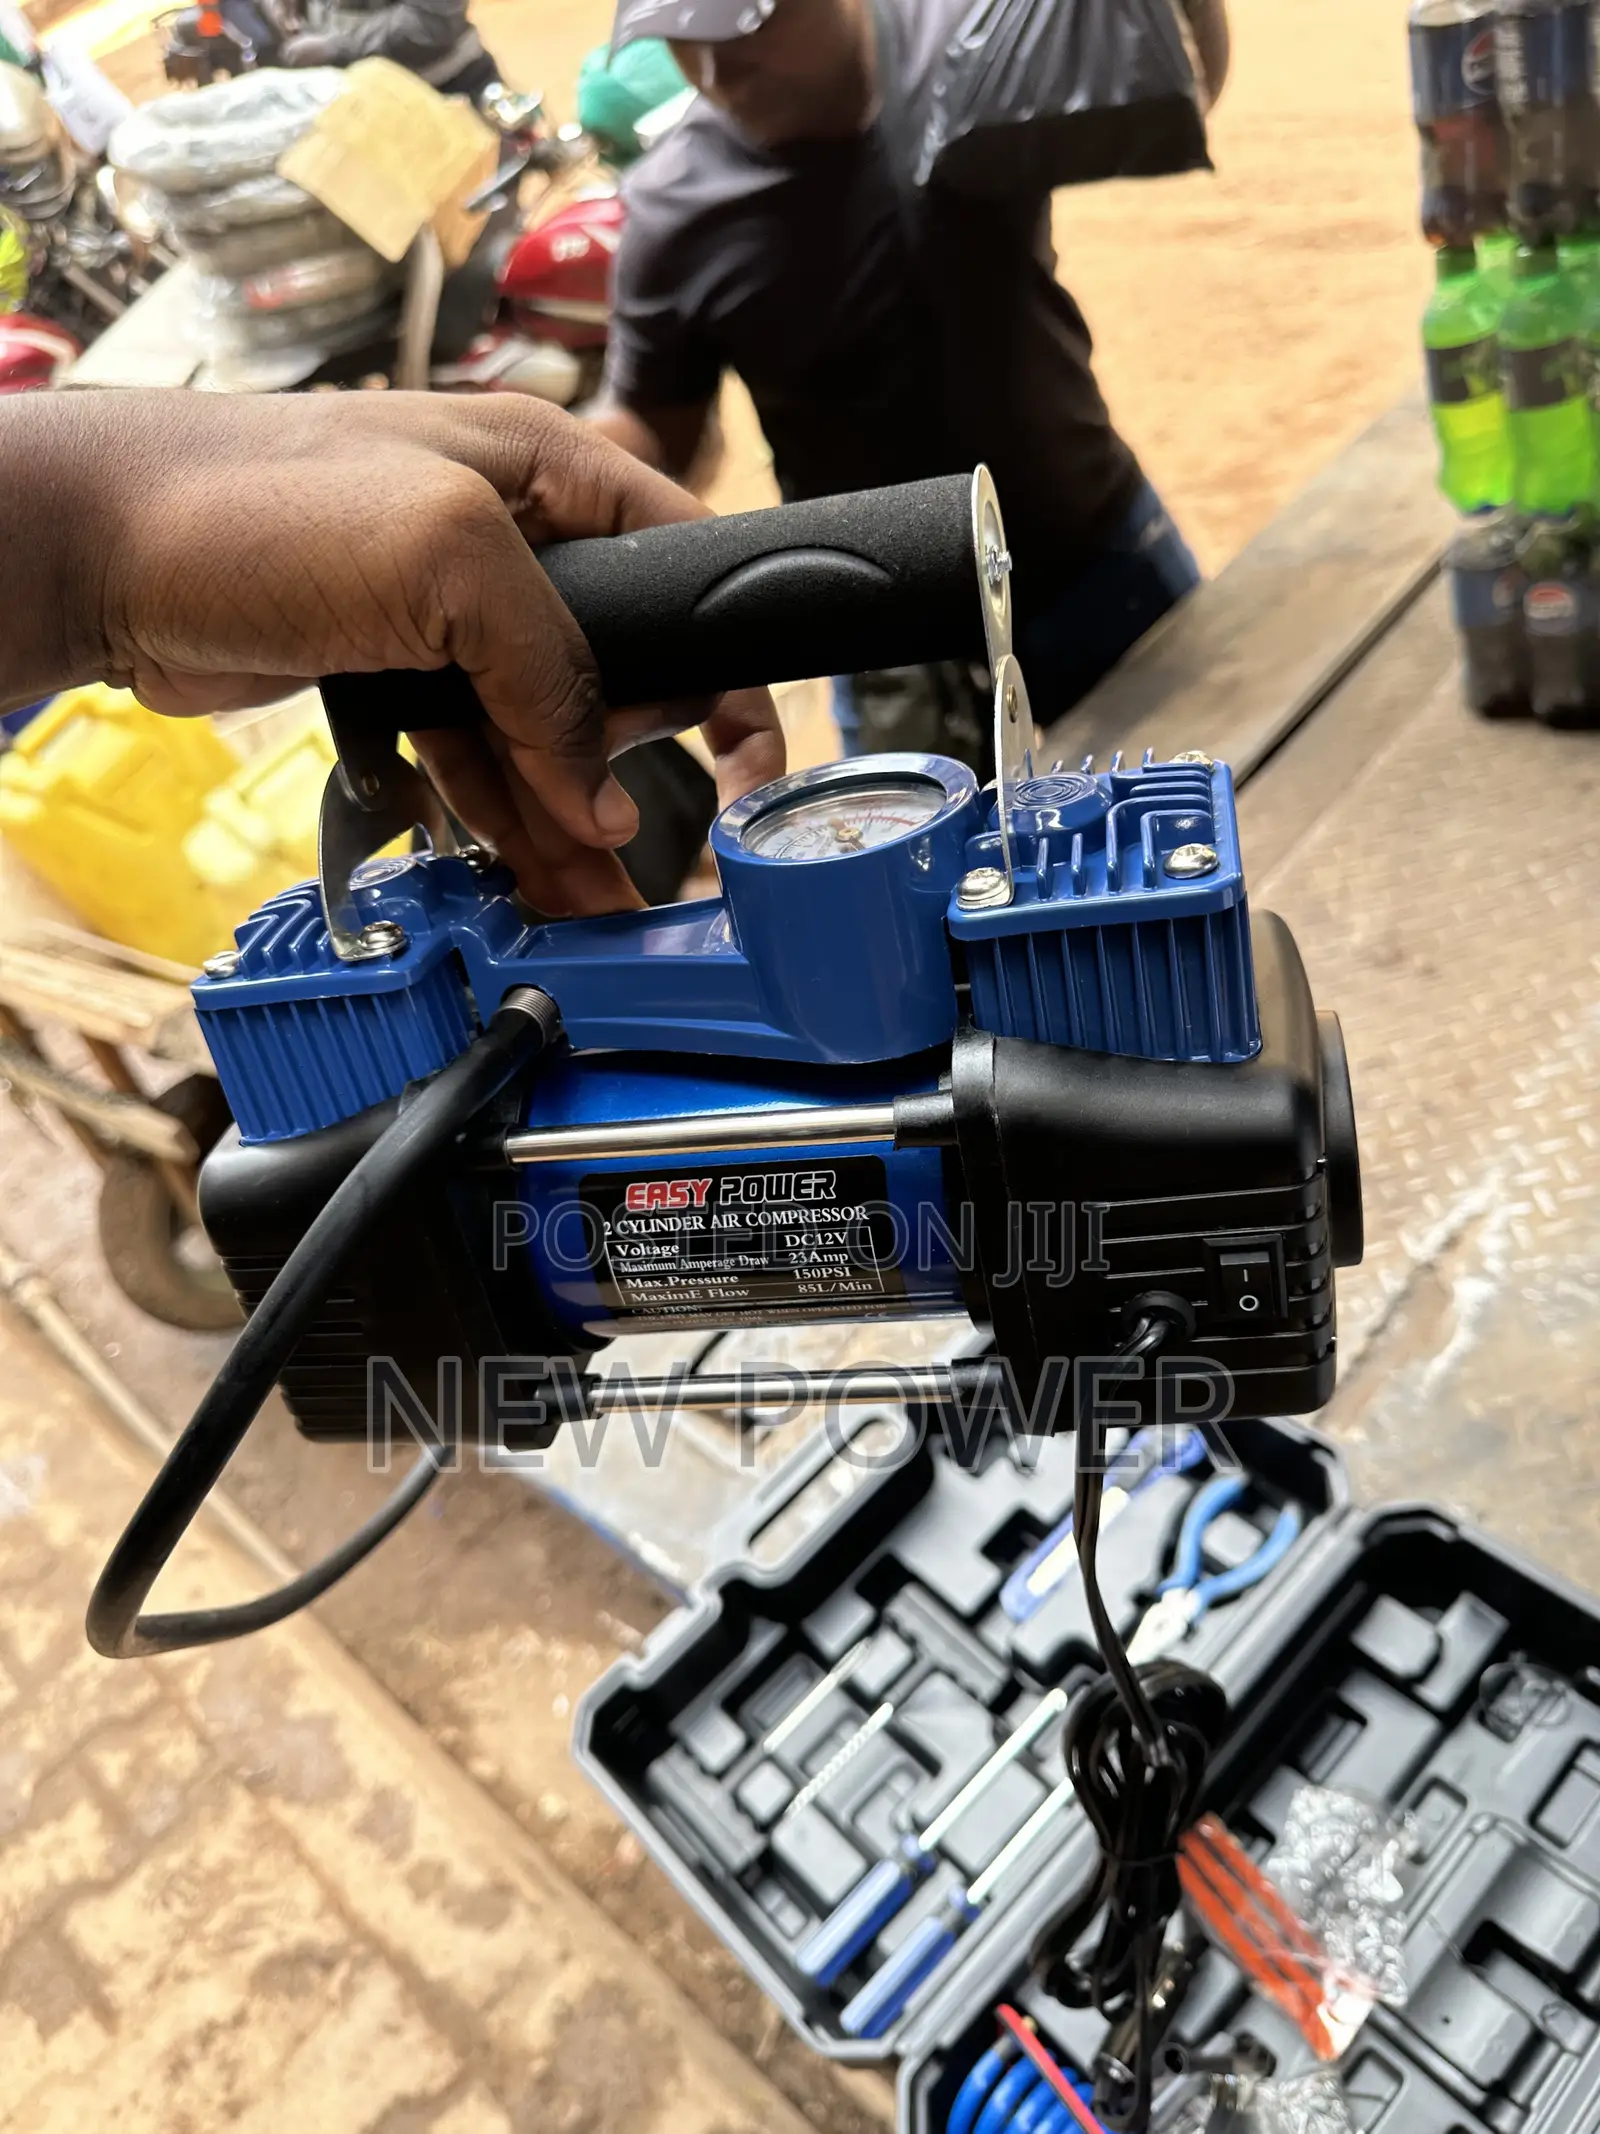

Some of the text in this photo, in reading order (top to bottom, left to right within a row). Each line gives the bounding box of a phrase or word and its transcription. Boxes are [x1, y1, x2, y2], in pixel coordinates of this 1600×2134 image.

[625, 1170, 837, 1212] EASY POWER
[603, 1205, 870, 1236] 2 CYLINDER AIR COMPRESSOR
[615, 1232, 848, 1258] Voltage DC12V
[620, 1260, 676, 1273] Maximum
[680, 1257, 736, 1271] Amperage
[738, 1254, 769, 1266] Draw
[625, 1266, 852, 1289] Max.Pressure 150PSI
[708, 1288, 750, 1299] Flow
[798, 1281, 873, 1294] 85L/Min
